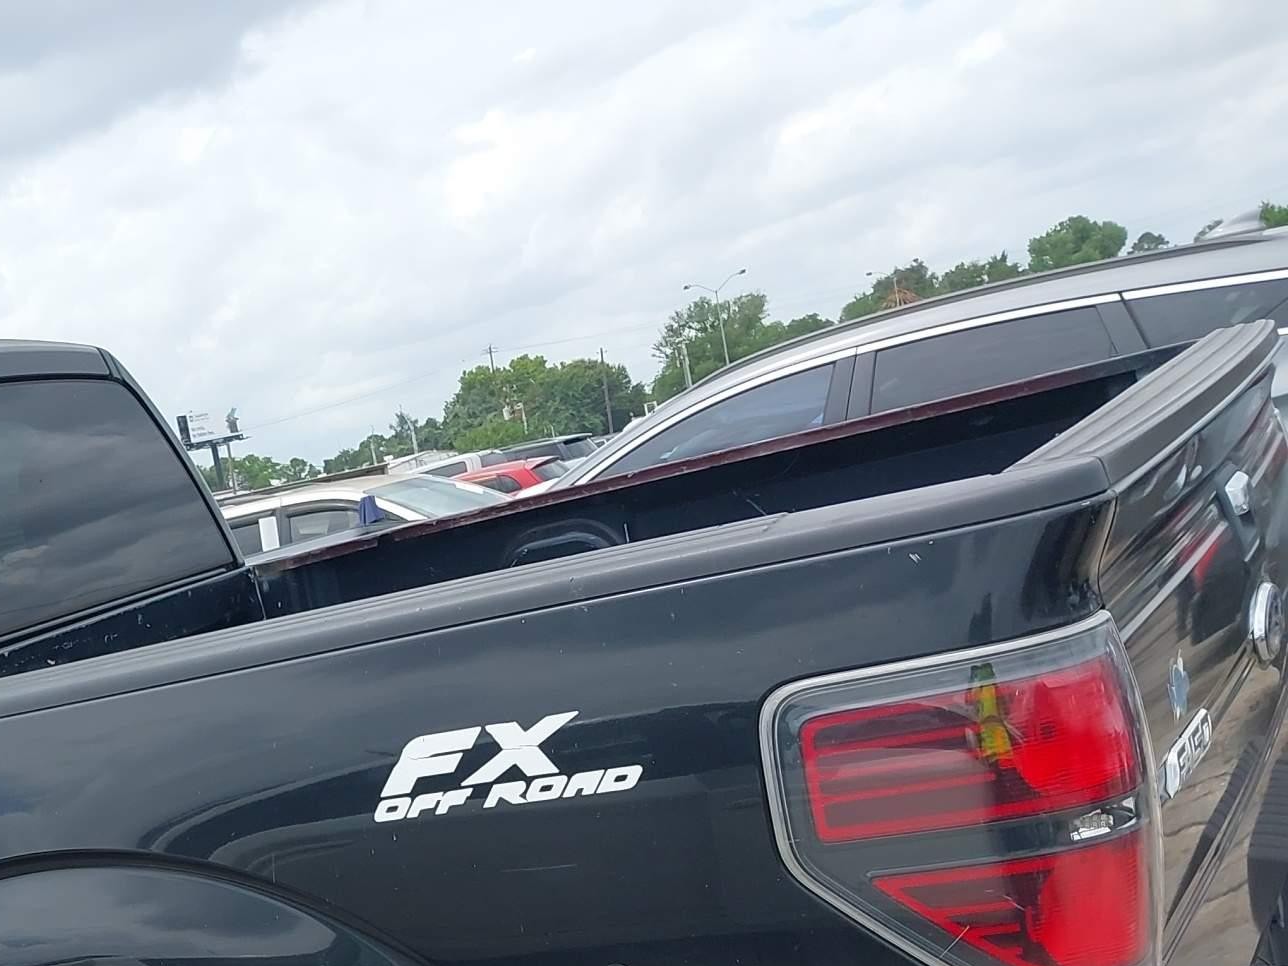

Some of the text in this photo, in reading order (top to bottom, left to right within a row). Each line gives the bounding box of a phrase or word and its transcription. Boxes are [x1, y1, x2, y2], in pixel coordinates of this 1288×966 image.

[380, 710, 580, 798] FX
[374, 764, 644, 823] OFF ROAD
